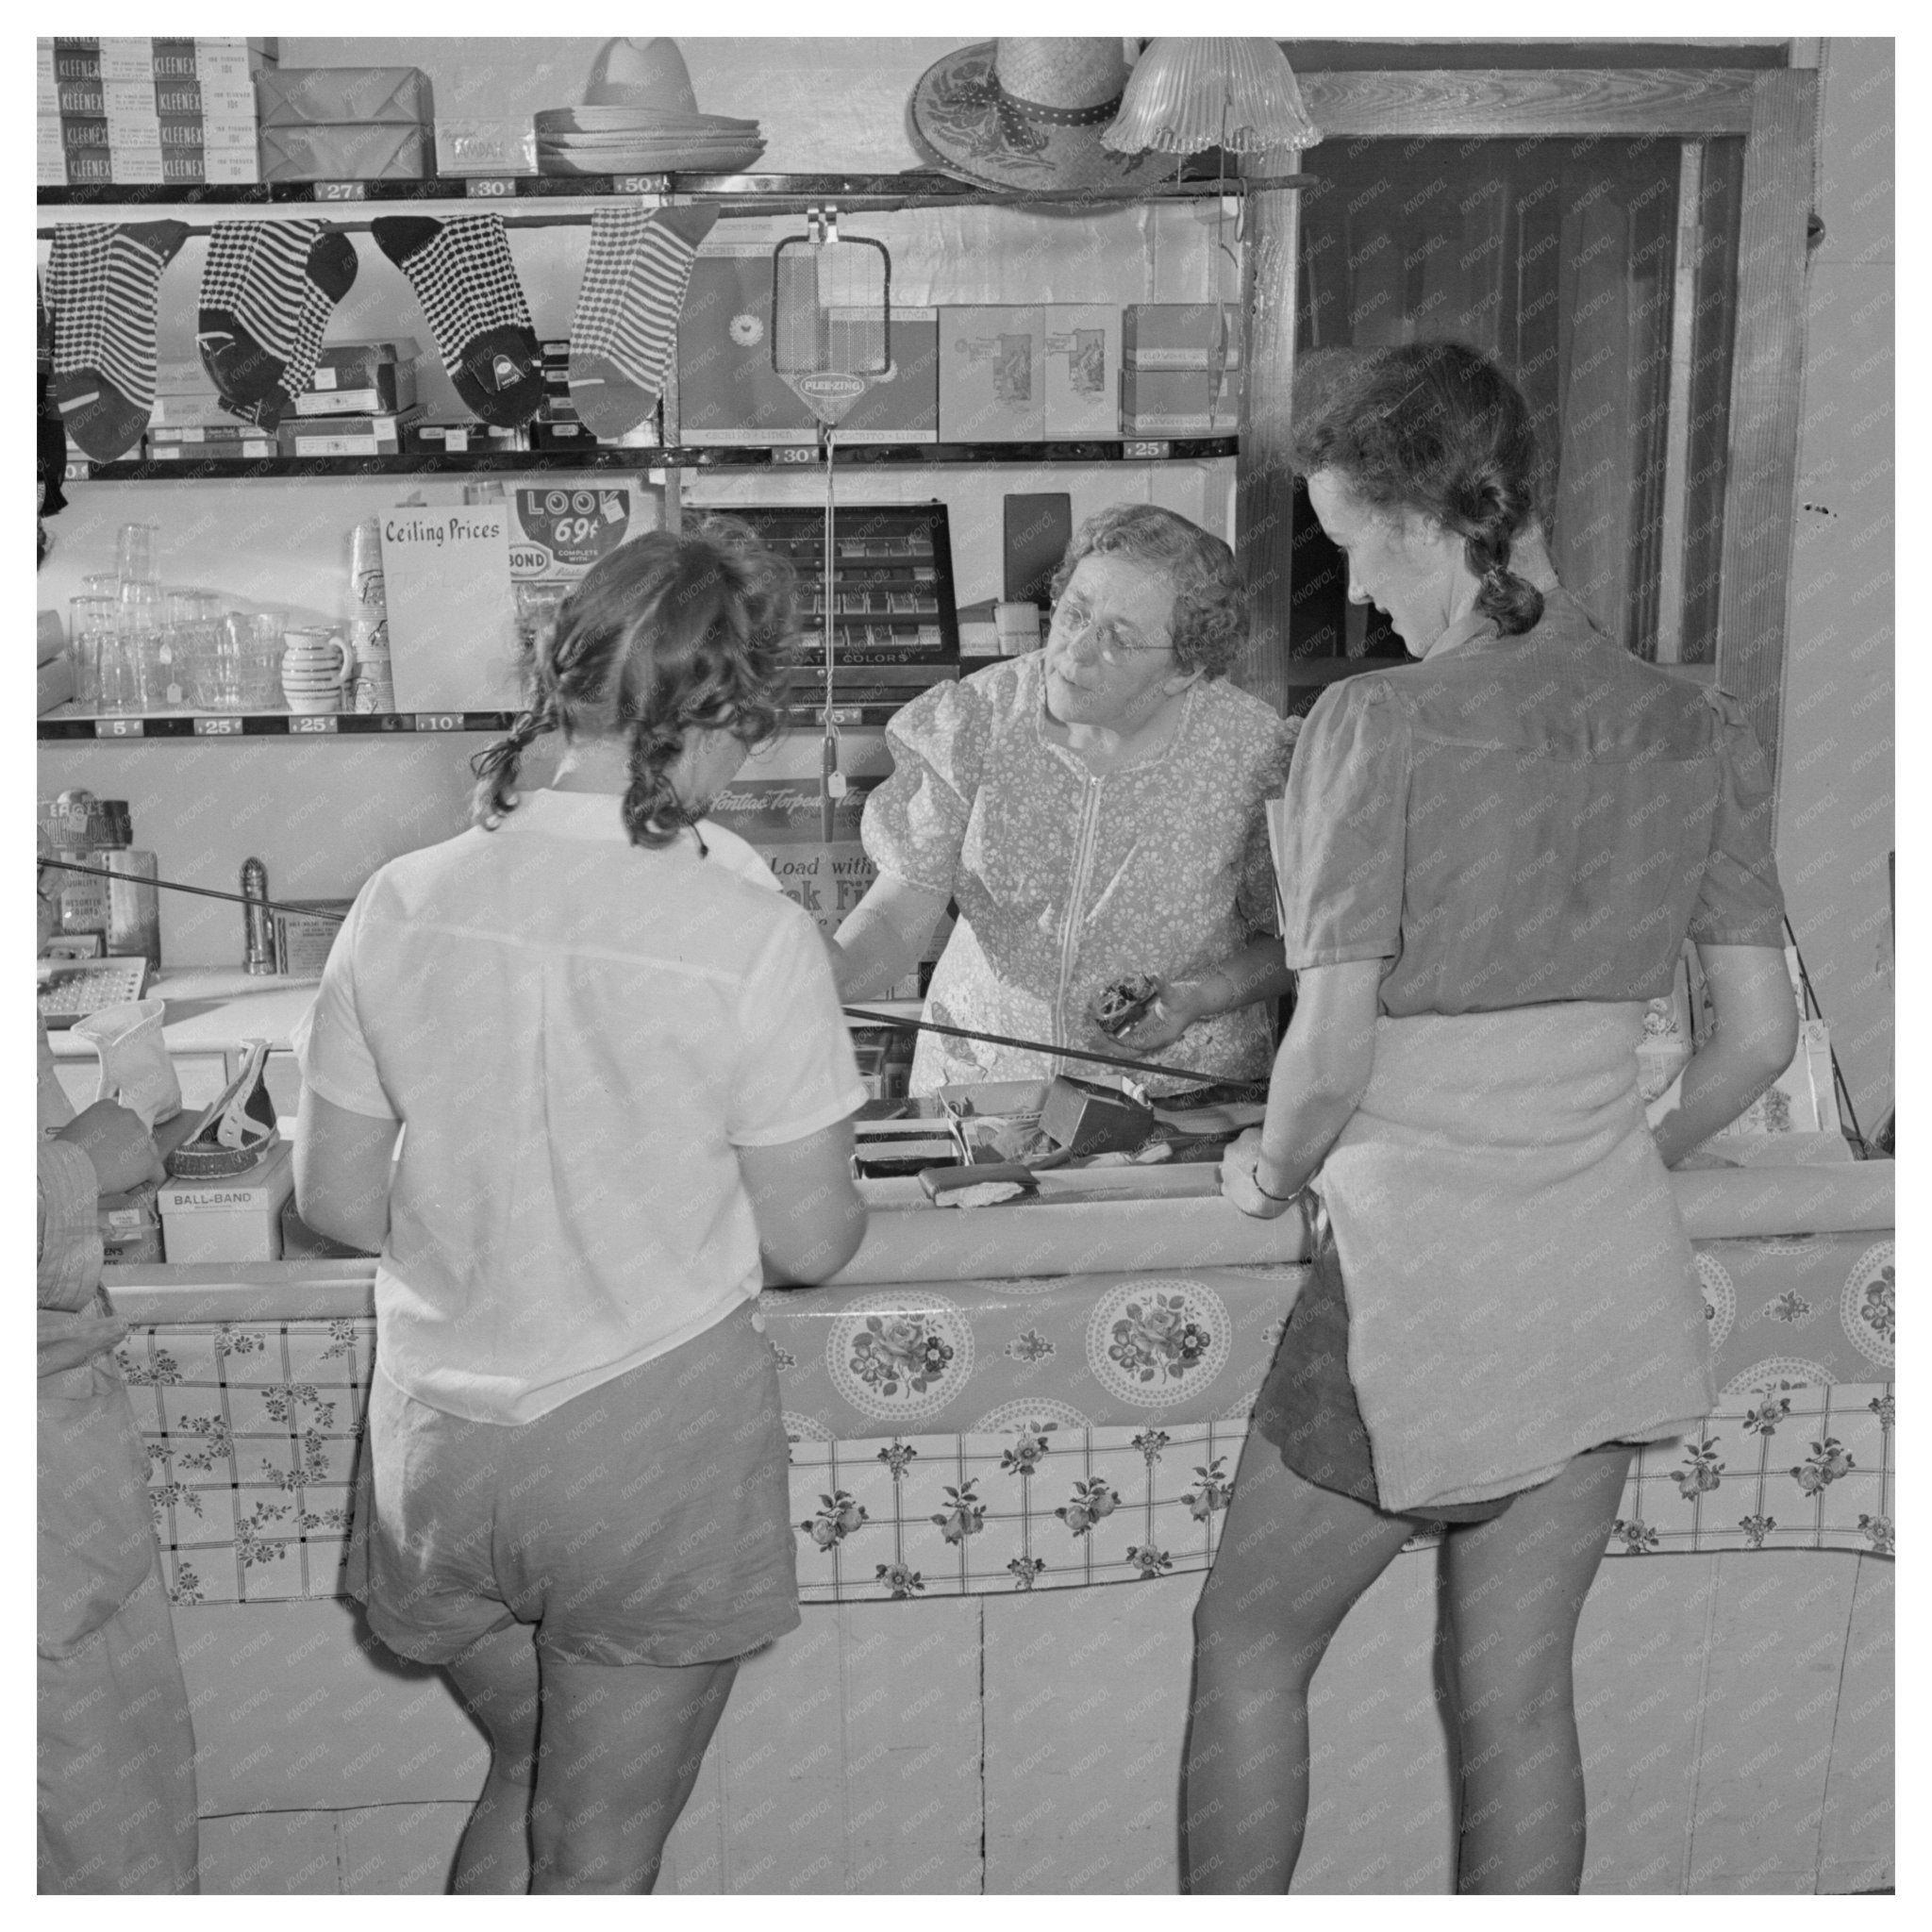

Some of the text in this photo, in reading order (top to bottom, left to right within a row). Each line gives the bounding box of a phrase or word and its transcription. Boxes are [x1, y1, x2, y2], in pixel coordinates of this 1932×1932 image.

[58, 59, 100, 76] KLEENEX
[154, 57, 195, 74] KLEENEX
[62, 93, 103, 110] KLEENEX
[159, 93, 201, 110] KLEENEX
[67, 127, 108, 144] KLEENEX
[161, 126, 203, 144] KLEENEX
[70, 160, 110, 177] KLEENEX
[164, 159, 205, 177] KLEENEX
[526, 490, 620, 516] LOOK
[385, 518, 500, 547] Ceiling Prices
[842, 654, 908, 663] COLORS
[770, 857, 873, 875] Load with
[174, 1192, 252, 1206] BALL-BAND
